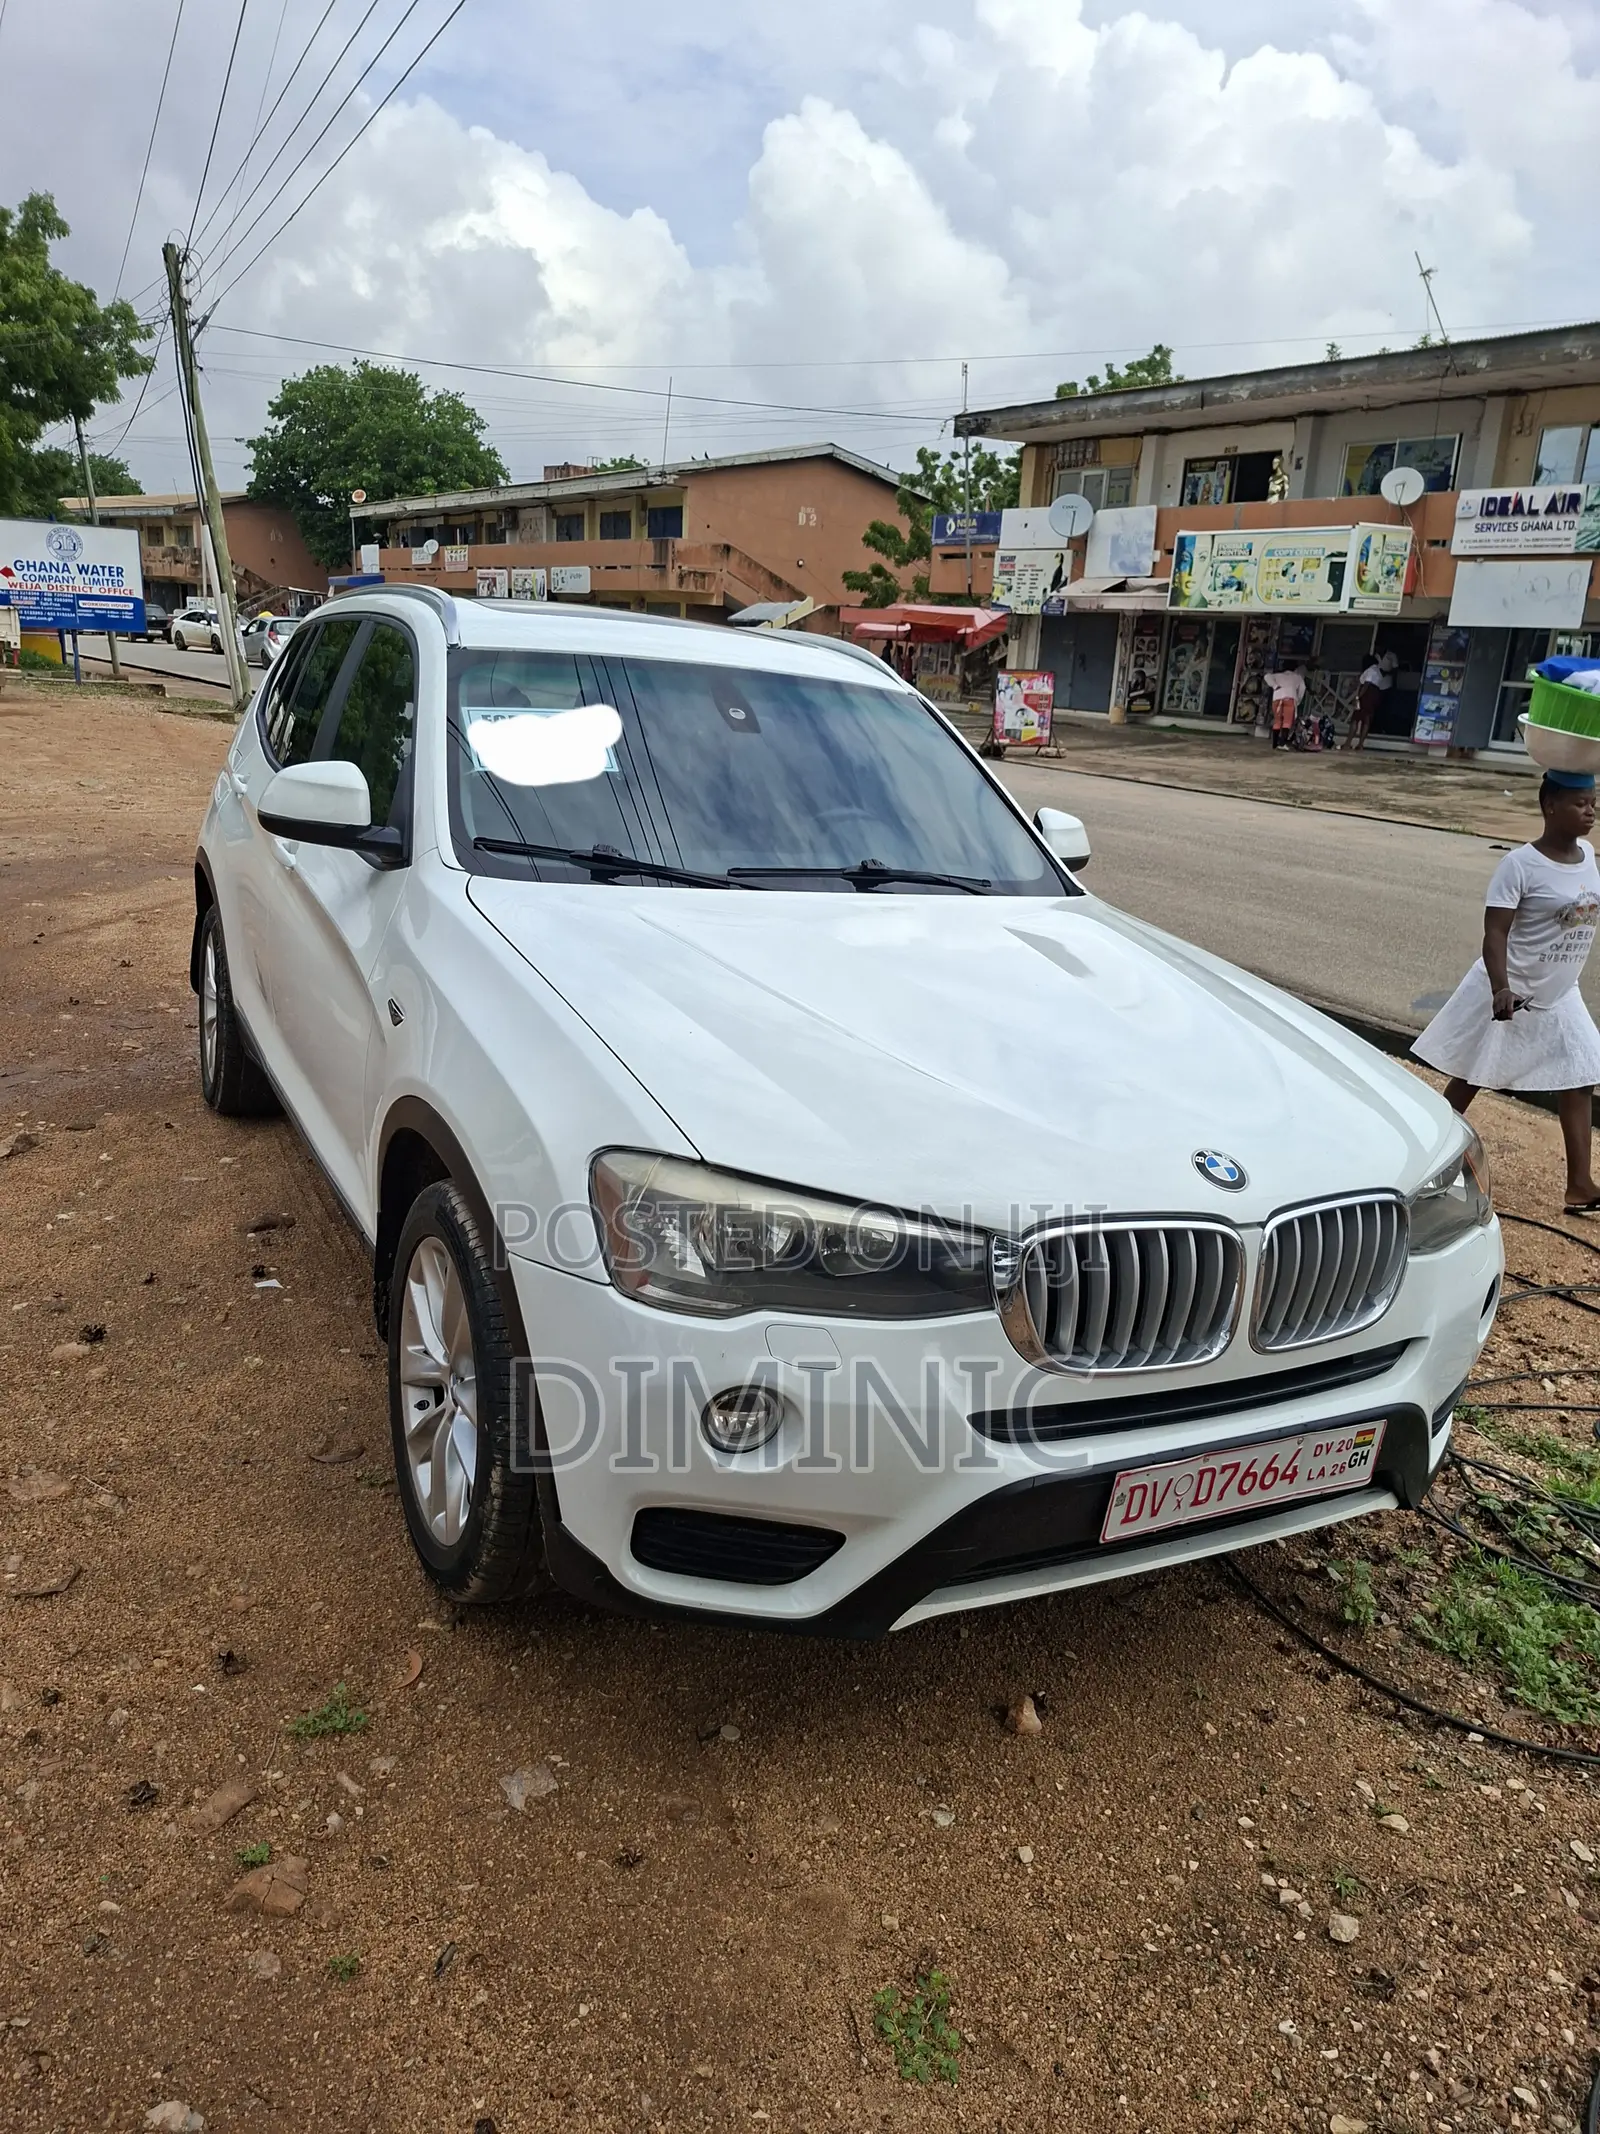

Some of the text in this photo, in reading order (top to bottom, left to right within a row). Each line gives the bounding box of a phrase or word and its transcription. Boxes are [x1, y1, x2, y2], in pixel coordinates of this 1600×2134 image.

[1480, 491, 1582, 517] IDEAL AIR
[1474, 520, 1577, 533] SERVICES GHANA LTD.
[1273, 549, 1294, 557] COPY
[14, 560, 124, 578] GHANA WATER
[8, 581, 42, 591] WEIJA
[47, 585, 93, 594] DISTRICT
[99, 588, 134, 596] OFFICE
[22, 573, 124, 588] COMPANY LIMITED
[1312, 1438, 1354, 1458] DV 20
[1348, 1449, 1371, 1469] GH
[1306, 1461, 1347, 1481] LA 26
[1120, 1446, 1303, 1525] DV D7664
